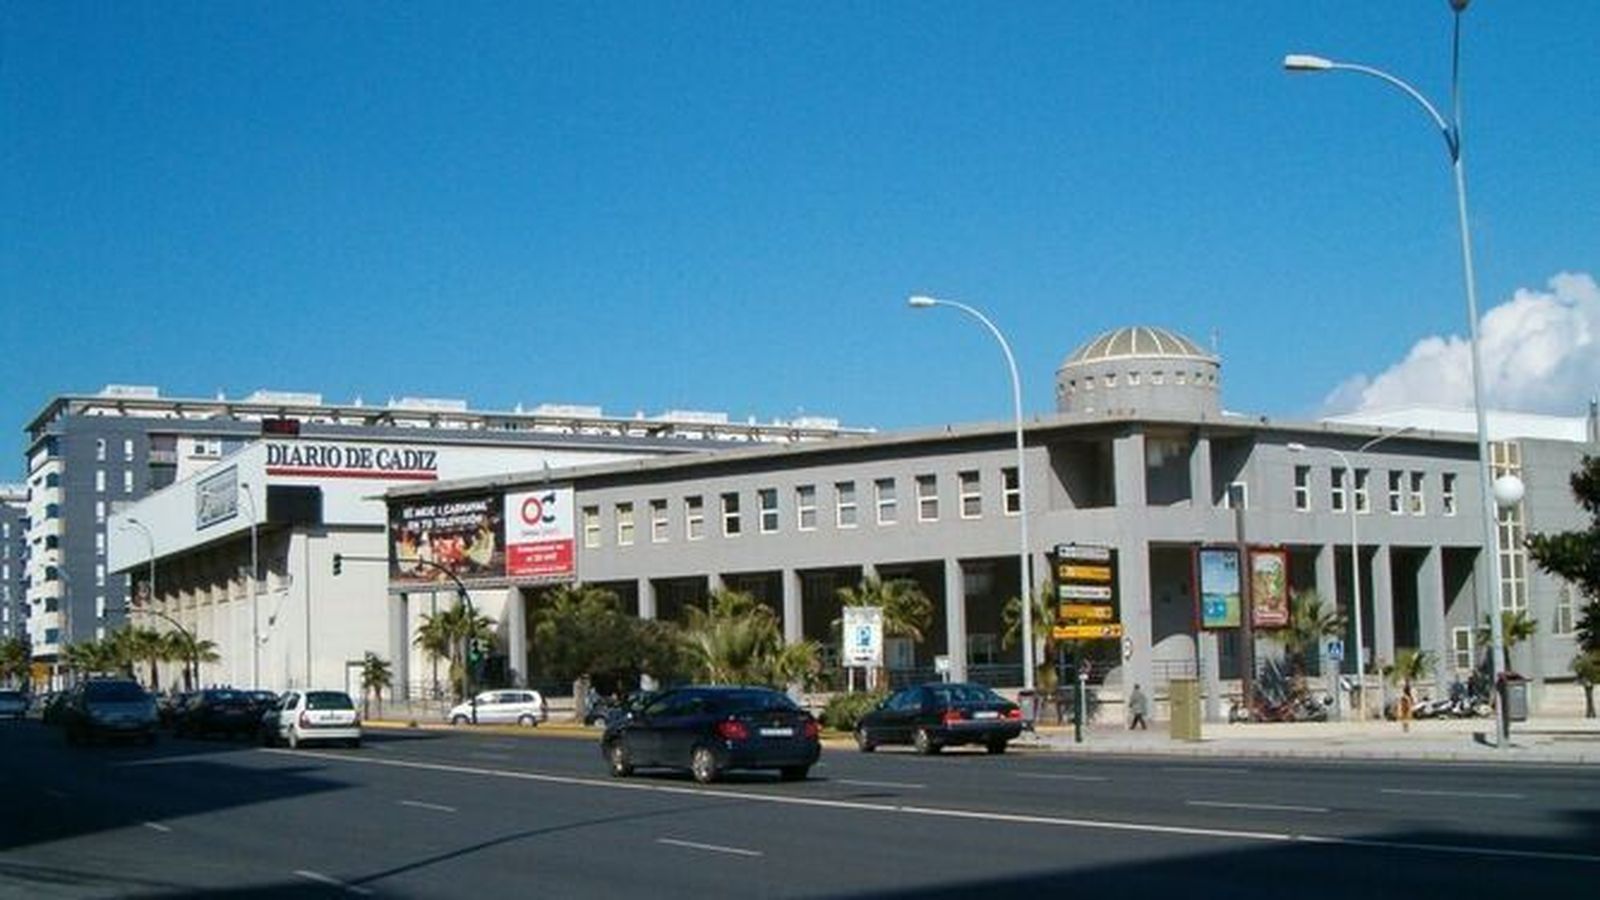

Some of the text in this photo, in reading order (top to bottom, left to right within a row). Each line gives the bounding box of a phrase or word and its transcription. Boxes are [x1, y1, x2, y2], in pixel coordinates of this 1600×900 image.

[266, 444, 437, 471] DIARIO DE CADIZ
